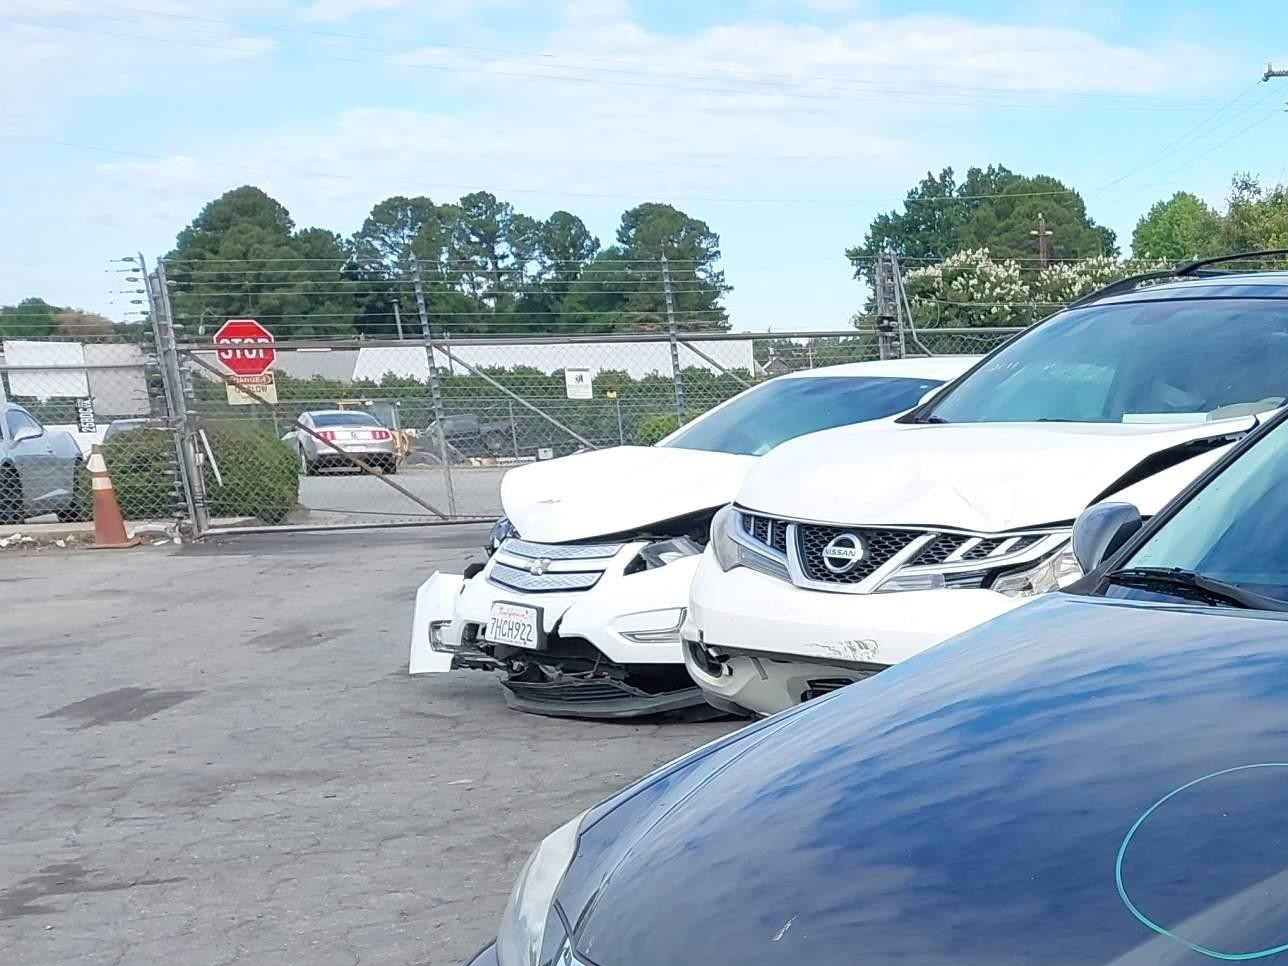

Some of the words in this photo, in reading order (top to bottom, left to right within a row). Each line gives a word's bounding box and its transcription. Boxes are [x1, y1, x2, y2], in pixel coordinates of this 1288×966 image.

[219, 338, 270, 359] STOP
[825, 548, 857, 557] NISSAN
[490, 617, 533, 642] 7HCH922
